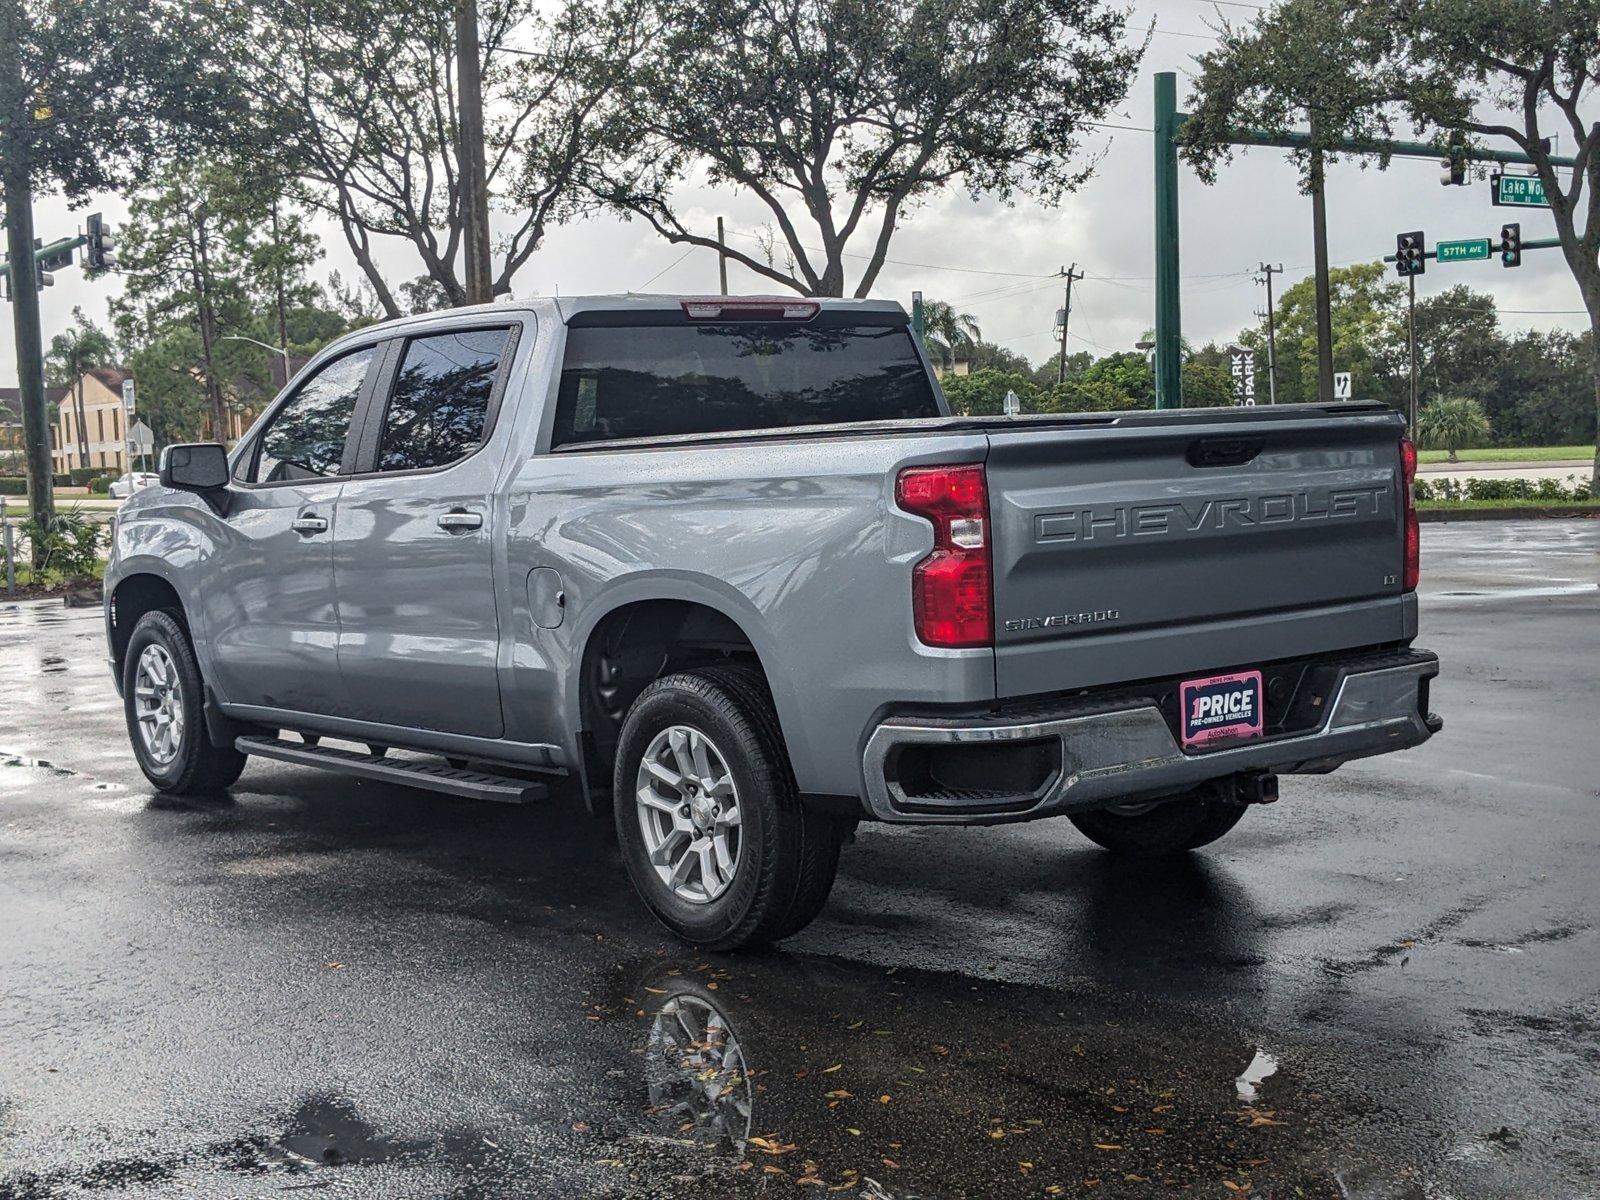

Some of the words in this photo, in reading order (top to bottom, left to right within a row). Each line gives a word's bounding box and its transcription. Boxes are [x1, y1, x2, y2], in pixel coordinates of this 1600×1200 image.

[1502, 179, 1525, 195] Lake
[1443, 246, 1467, 257] 57TH
[1469, 245, 1482, 254] AVE
[1245, 353, 1254, 395] PARK
[1033, 486, 1389, 545] CHEVROLET
[1383, 575, 1397, 586] LT
[1005, 609, 1120, 631] SILVERADO
[1190, 714, 1224, 727] PRE-OWNED
[1225, 711, 1251, 720] VEHICLES
[1207, 728, 1238, 738] AutoNation
